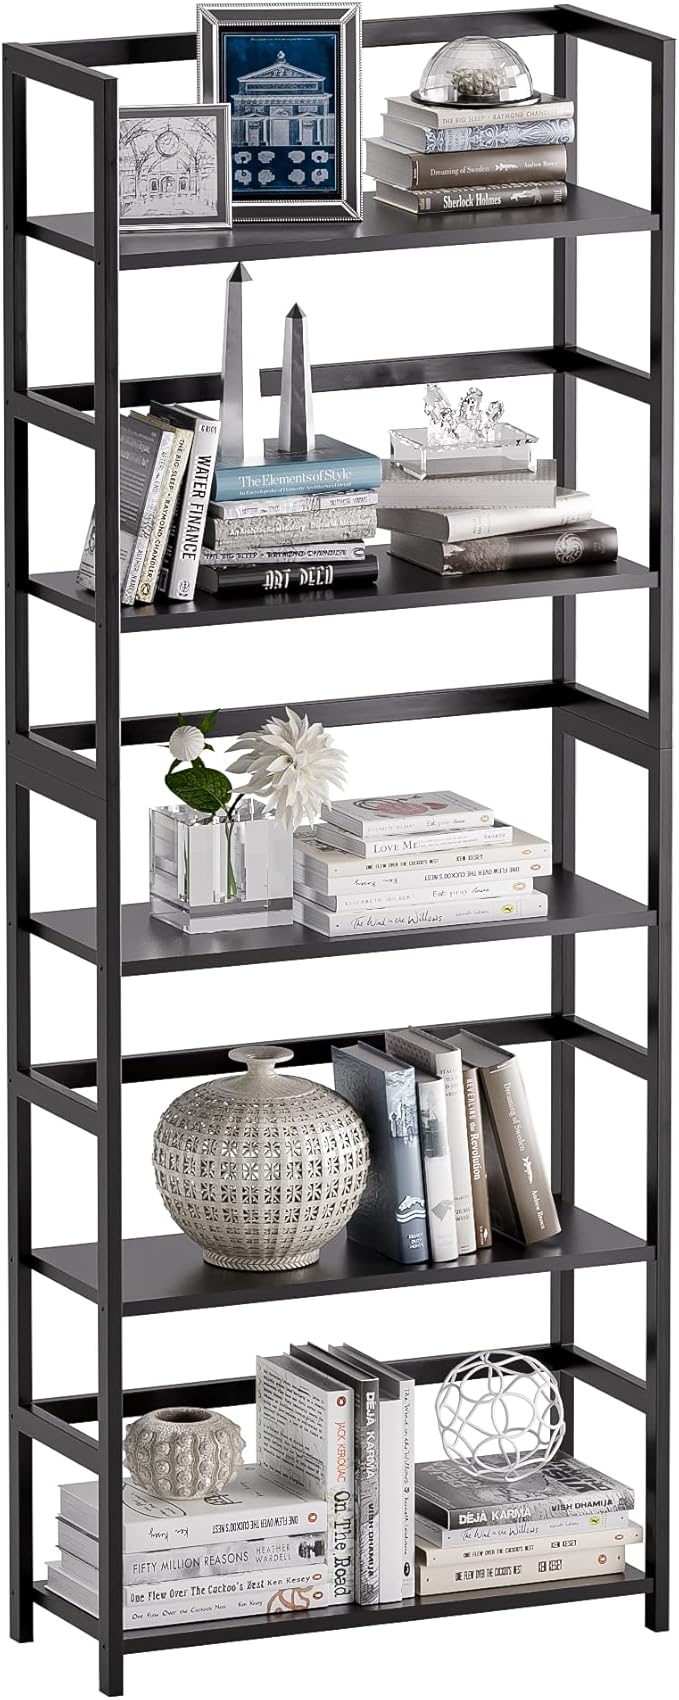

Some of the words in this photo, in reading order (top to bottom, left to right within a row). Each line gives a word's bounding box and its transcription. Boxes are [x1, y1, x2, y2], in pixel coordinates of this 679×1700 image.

[430, 166, 459, 177] Dreaming
[443, 195, 474, 209] Sherlock
[476, 193, 501, 206] Holmes
[174, 454, 182, 468] BIG
[168, 470, 178, 490] SLEEP
[194, 455, 212, 502] WATER
[239, 476, 260, 488] The
[262, 472, 311, 486] Elements
[312, 469, 325, 481] of
[325, 468, 352, 482] Style
[157, 500, 170, 538] RAYMOND
[182, 504, 204, 560] FINANCE
[147, 540, 161, 578] CHANDLER
[262, 568, 291, 590] ART
[300, 564, 334, 586] DECO
[373, 844, 398, 854] LOVE
[402, 840, 419, 850] ME
[504, 1082, 515, 1118] Dreaming
[512, 1116, 520, 1126] of
[514, 1124, 526, 1152] Sweden
[470, 1132, 482, 1180] Revolution
[334, 1422, 346, 1442] JACK
[336, 1444, 346, 1482] KEROUAC
[366, 1431, 376, 1480] KARMA
[334, 1490, 350, 1514] On
[552, 1504, 572, 1512] VISH
[574, 1500, 614, 1510] DHAMIJA
[250, 1519, 260, 1529] THE
[260, 1517, 273, 1528] OVER
[273, 1516, 288, 1526] FLEW
[288, 1515, 298, 1526] ONE
[492, 1508, 531, 1521] KARMA
[212, 1523, 226, 1534] NEST
[334, 1518, 352, 1550] The
[256, 1544, 291, 1554] HEATHER
[256, 1552, 291, 1563] WARDELL
[132, 1560, 157, 1574] FIFTY
[160, 1557, 200, 1572] MILLION
[204, 1552, 249, 1566] REASONS
[538, 1561, 547, 1572] KEN
[334, 1556, 352, 1598] Road
[130, 1593, 145, 1604] One
[148, 1590, 167, 1601] Flew
[169, 1588, 188, 1598] Over
[190, 1584, 206, 1596] The
[208, 1582, 244, 1594] Cuckoo's
[247, 1580, 264, 1590] Nest
[267, 1578, 283, 1586] Ken
[286, 1575, 310, 1584] Kesey
[162, 1608, 176, 1616] Over
